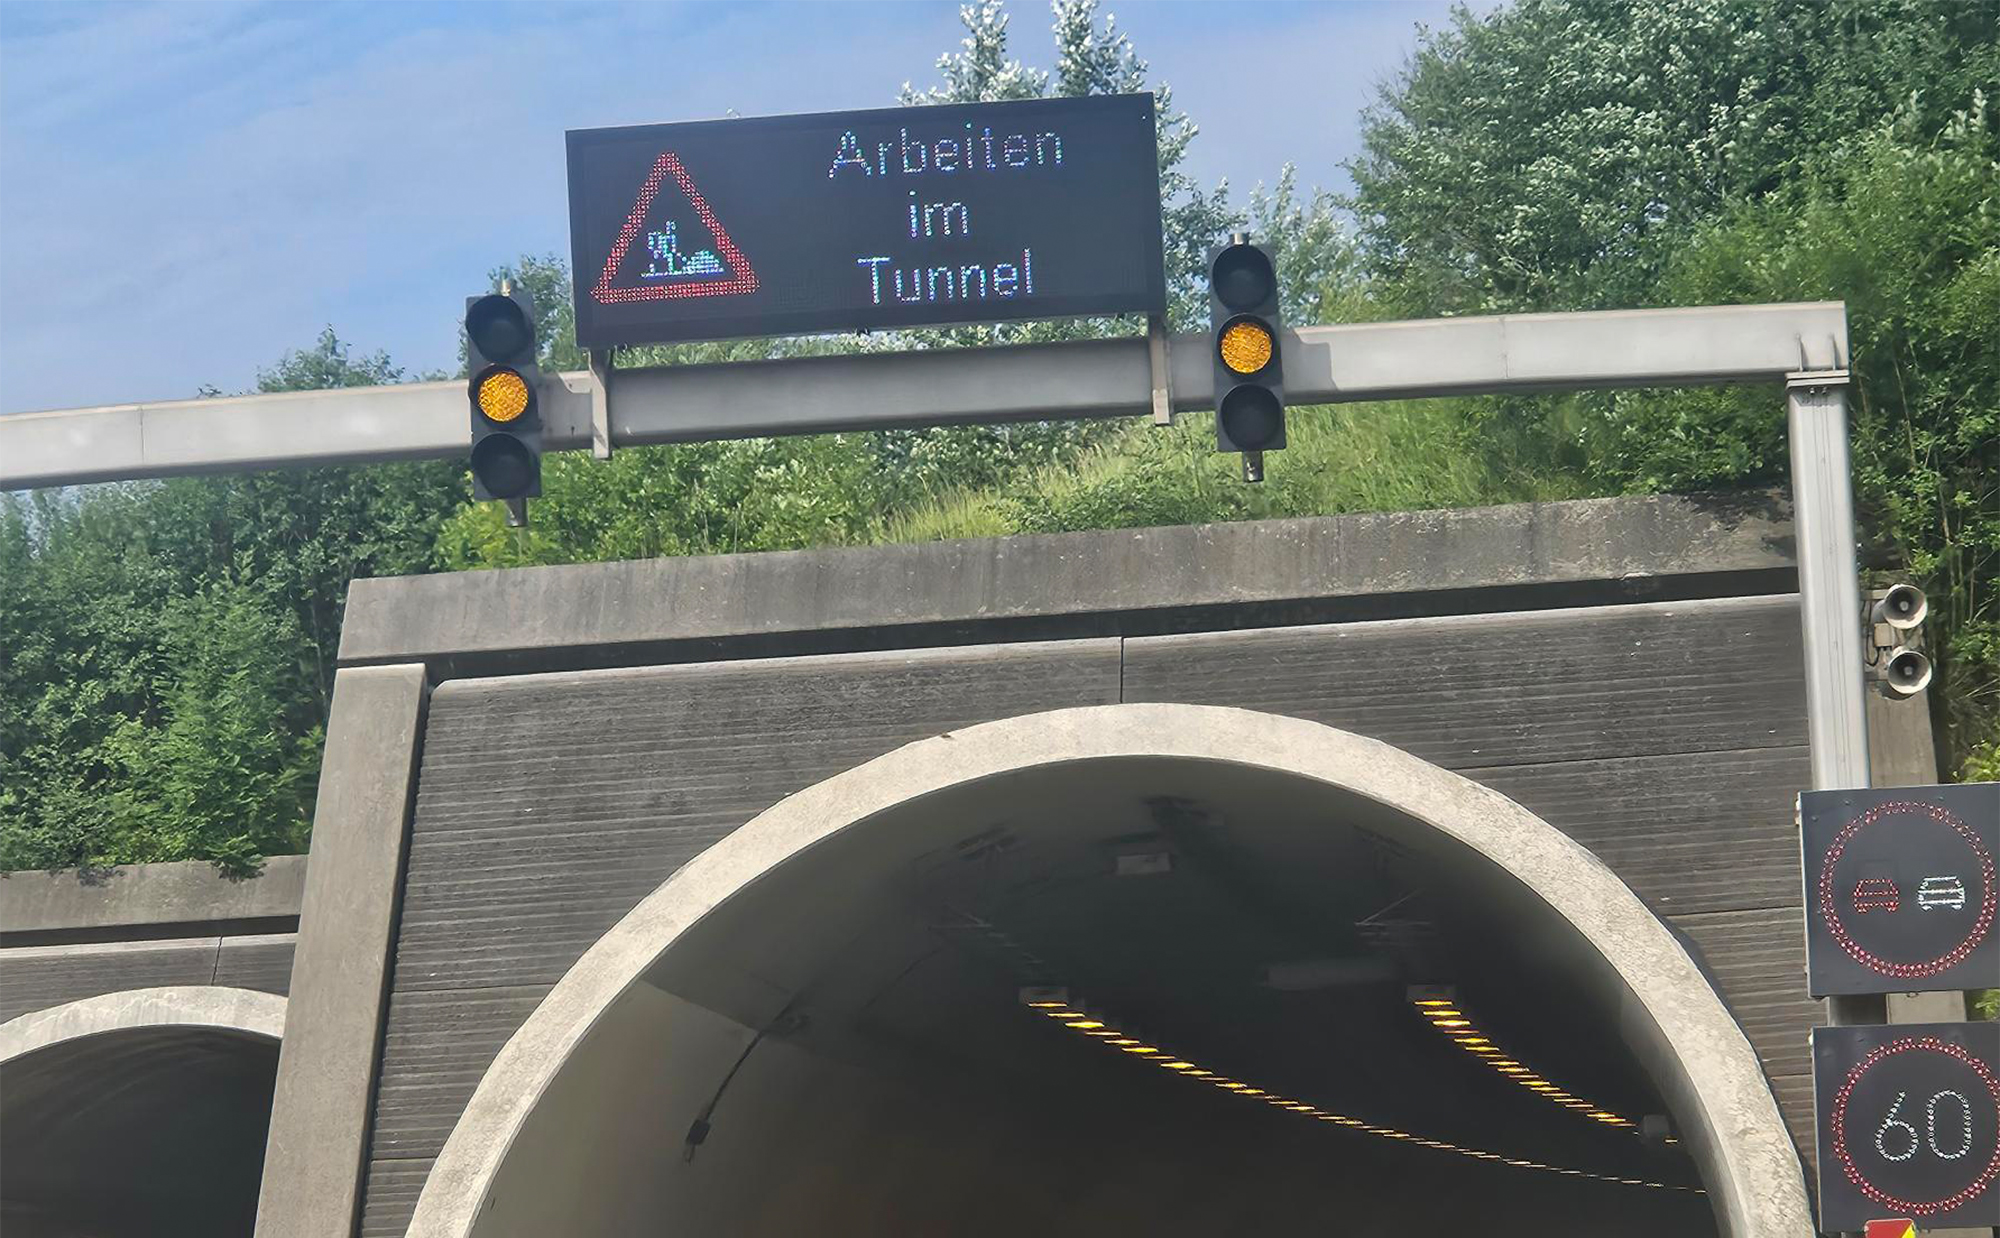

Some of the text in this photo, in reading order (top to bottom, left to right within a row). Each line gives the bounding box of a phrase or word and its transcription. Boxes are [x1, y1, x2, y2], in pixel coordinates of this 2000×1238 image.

[826, 120, 1064, 179] Arbeiten
[907, 190, 969, 238] im
[857, 247, 1033, 305] Tunnel
[1873, 1090, 1973, 1161] 60
